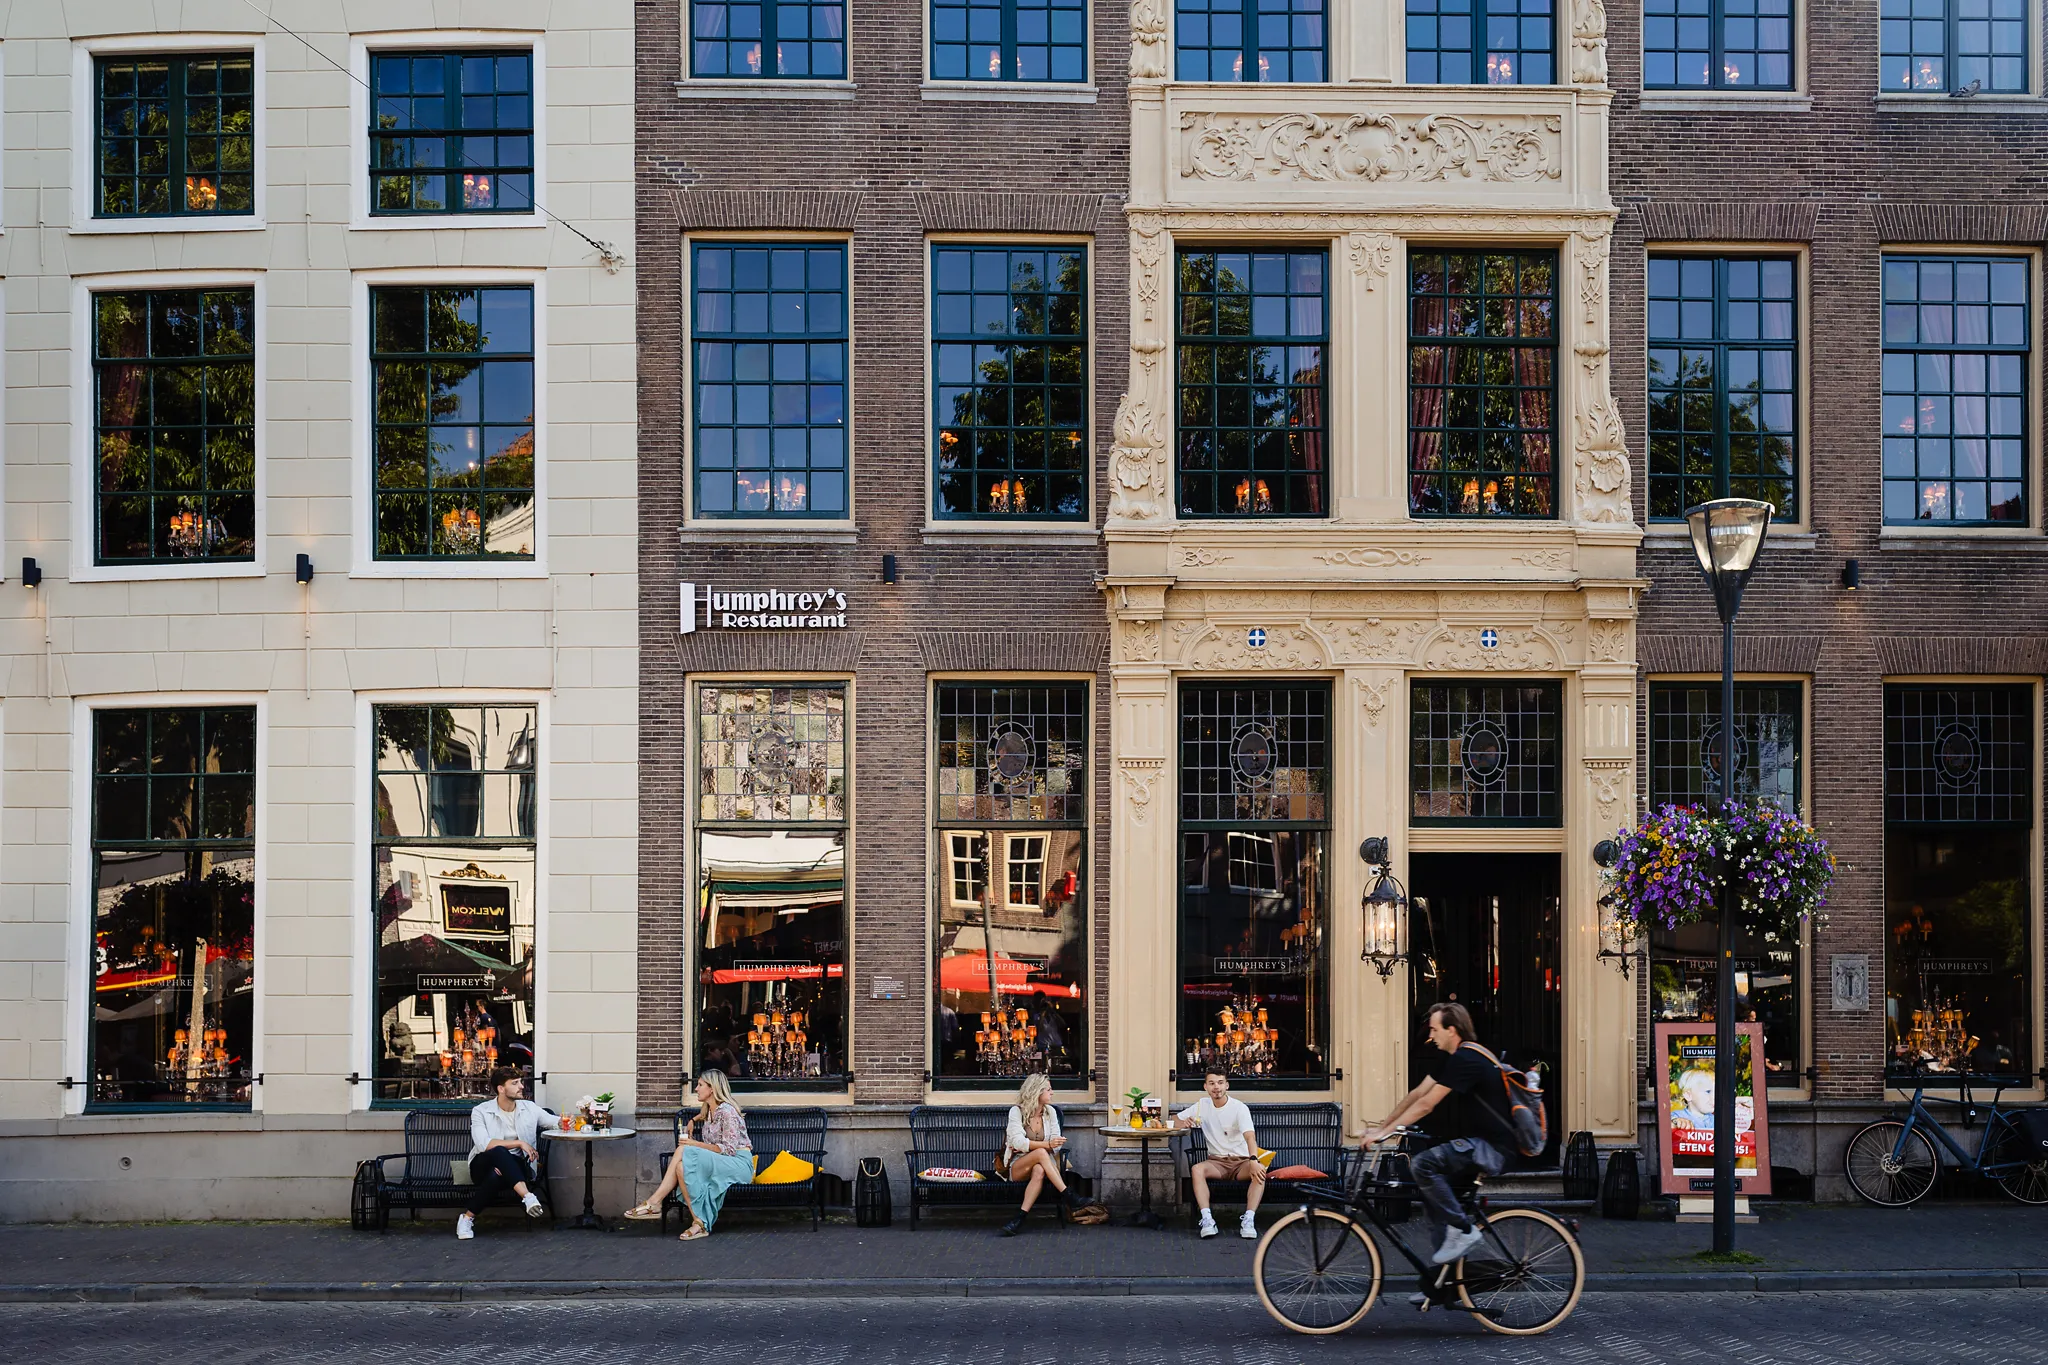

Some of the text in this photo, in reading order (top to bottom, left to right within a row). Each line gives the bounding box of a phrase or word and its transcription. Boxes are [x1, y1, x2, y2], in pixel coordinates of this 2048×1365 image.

[680, 582, 847, 634] Humphrey's
[723, 612, 847, 628] Restaurant
[739, 964, 806, 972] HUMPHREY'S
[978, 963, 1045, 971] HUMPHREY'S
[1220, 961, 1286, 969] HUMPHREY'S
[1923, 962, 1988, 970] HUMPHREY'S
[423, 978, 489, 986] HUMPHREY'S
[1679, 1143, 1706, 1153] ETEN
